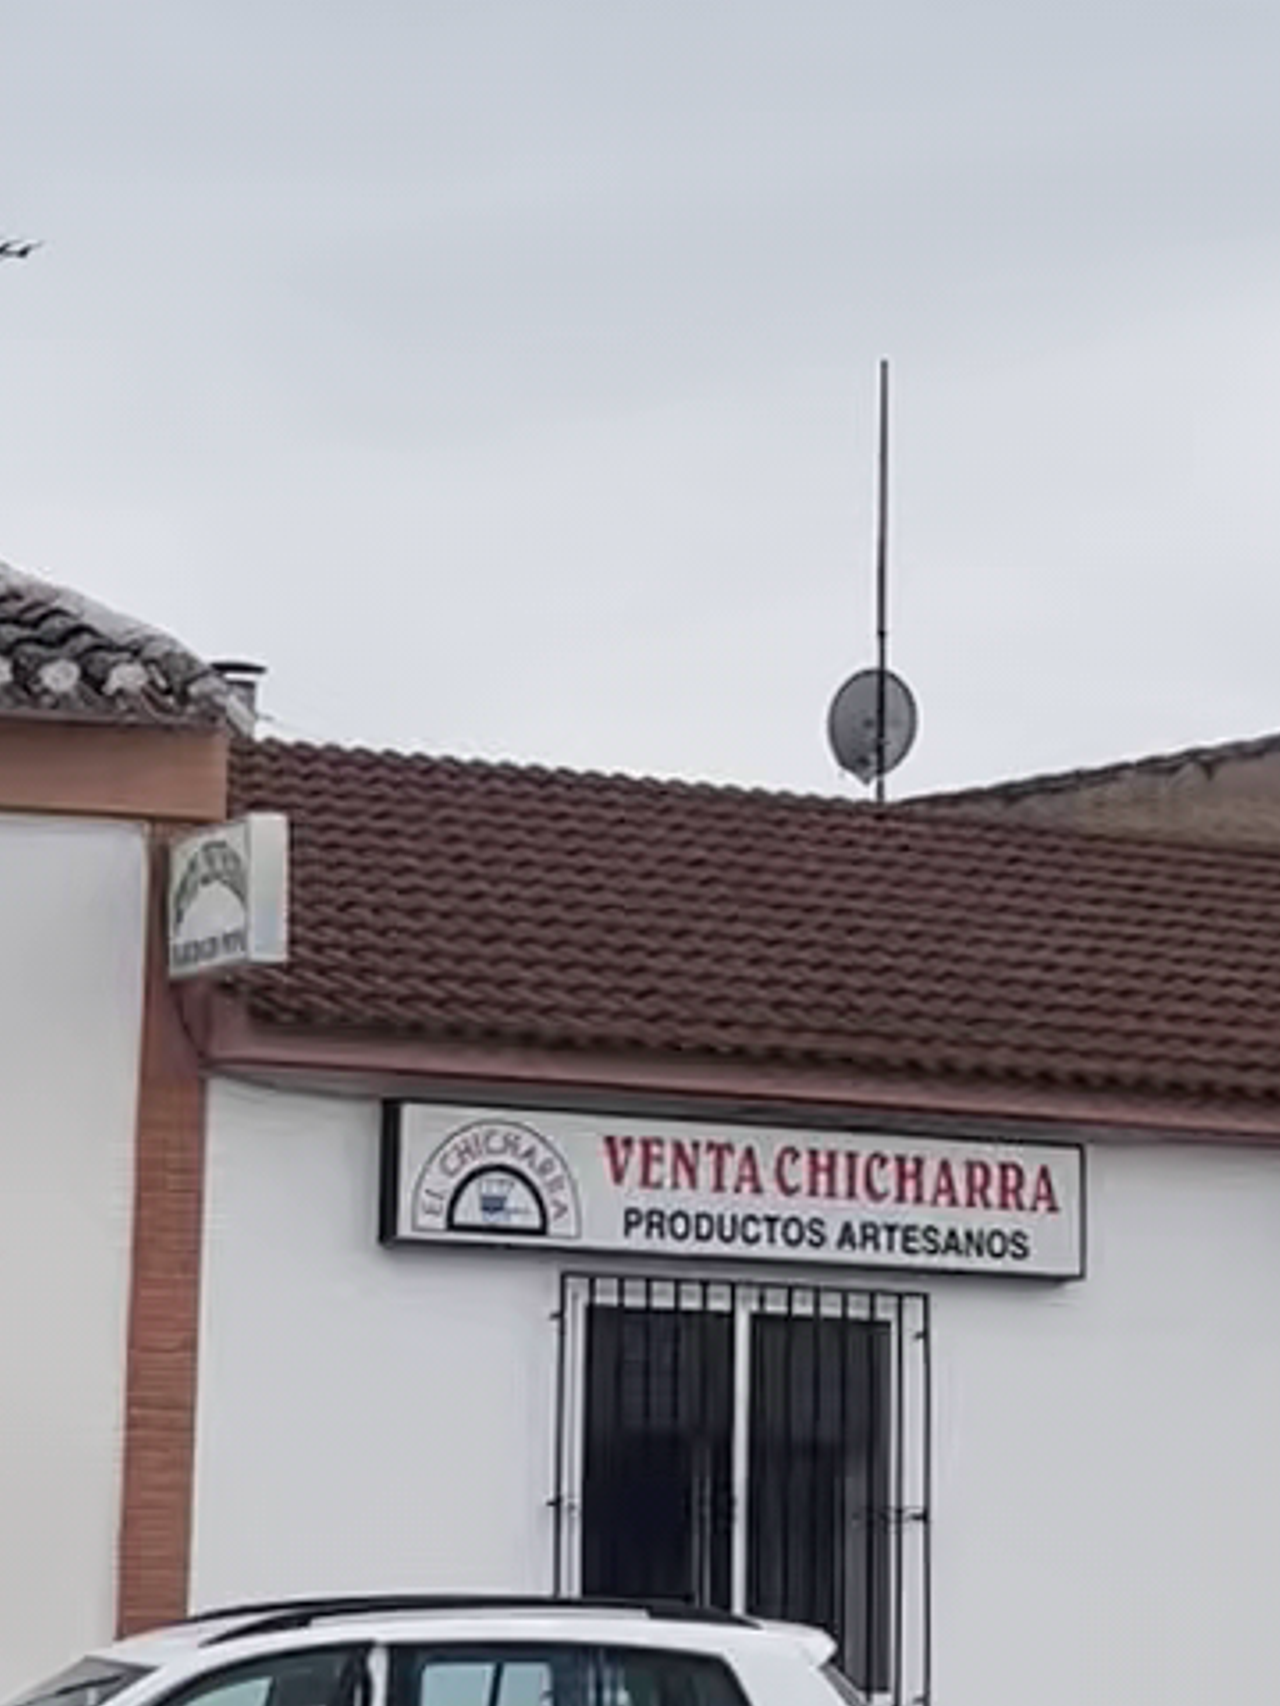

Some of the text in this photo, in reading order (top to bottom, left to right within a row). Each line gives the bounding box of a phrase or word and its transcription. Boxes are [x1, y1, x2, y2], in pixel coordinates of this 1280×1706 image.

[601, 1135, 1062, 1215] VENTA CHICHARRA
[622, 1205, 1032, 1262] PRODUCTOS ARTESANOS
